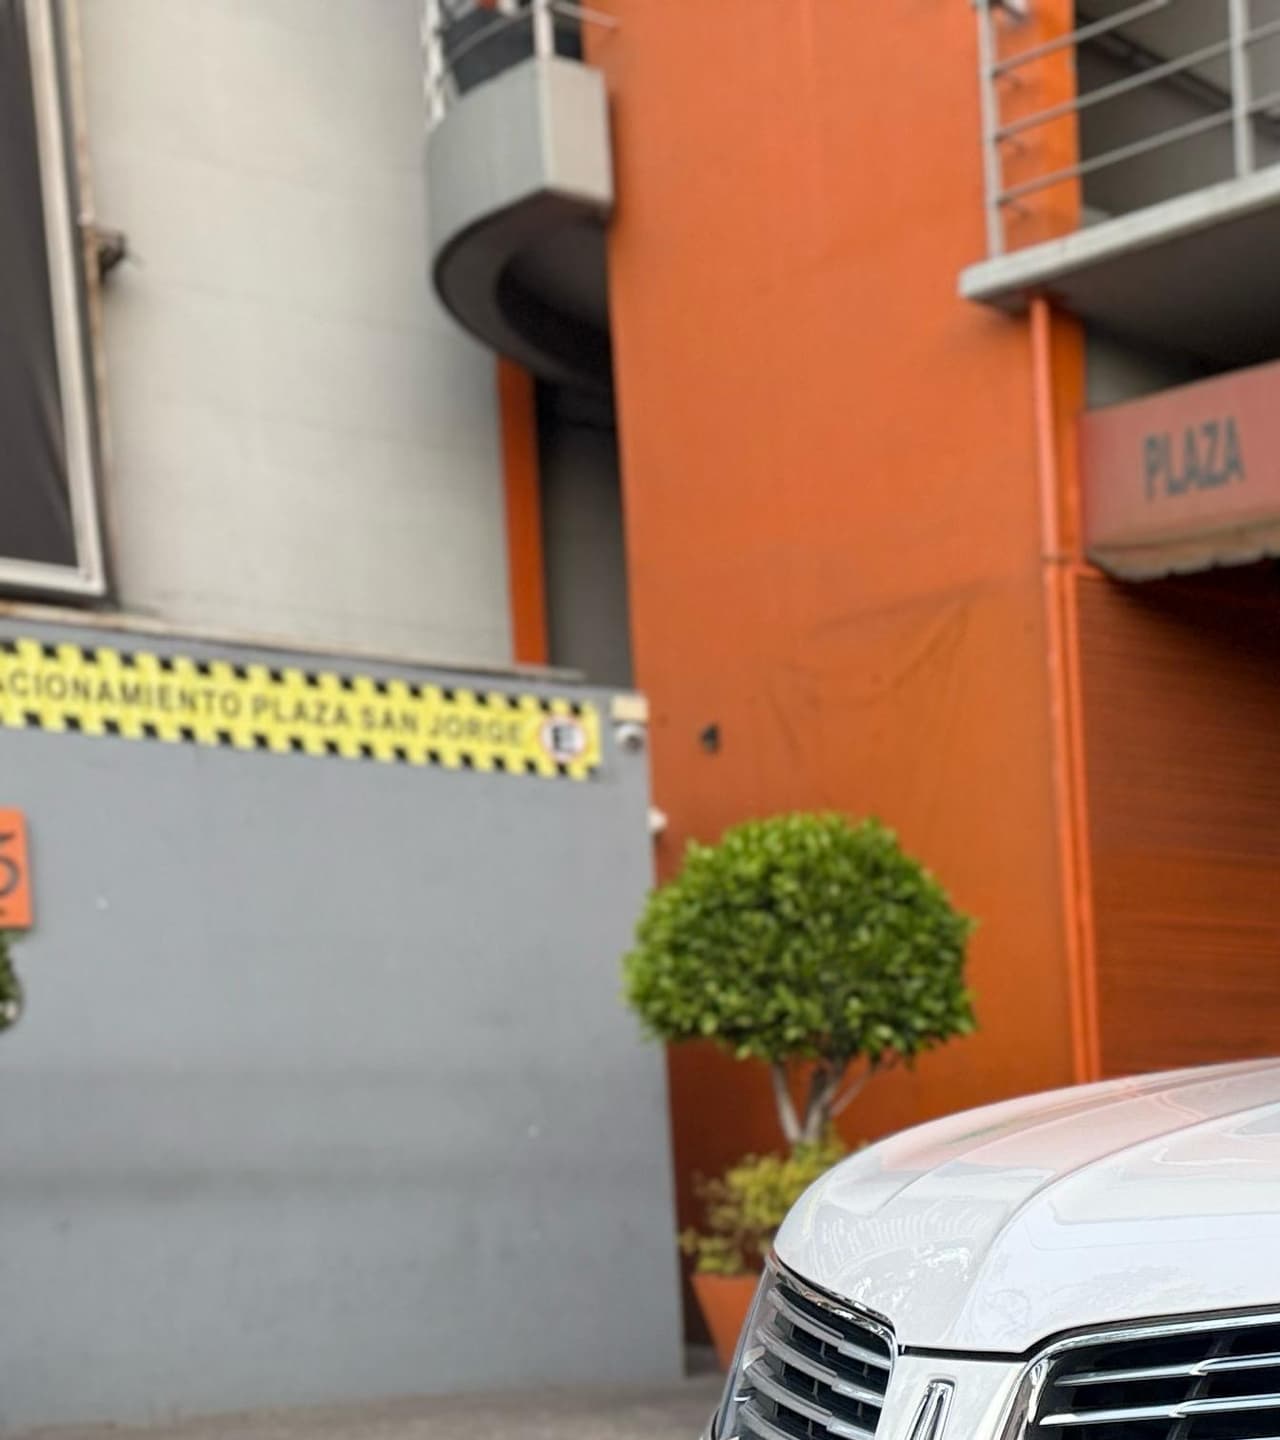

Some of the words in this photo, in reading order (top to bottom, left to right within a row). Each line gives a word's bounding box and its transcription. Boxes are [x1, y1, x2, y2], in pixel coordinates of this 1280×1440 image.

[1142, 417, 1247, 500] PLAZA
[252, 692, 351, 729] PLAZA
[361, 706, 420, 737] SAN
[428, 713, 524, 748] JORGE
